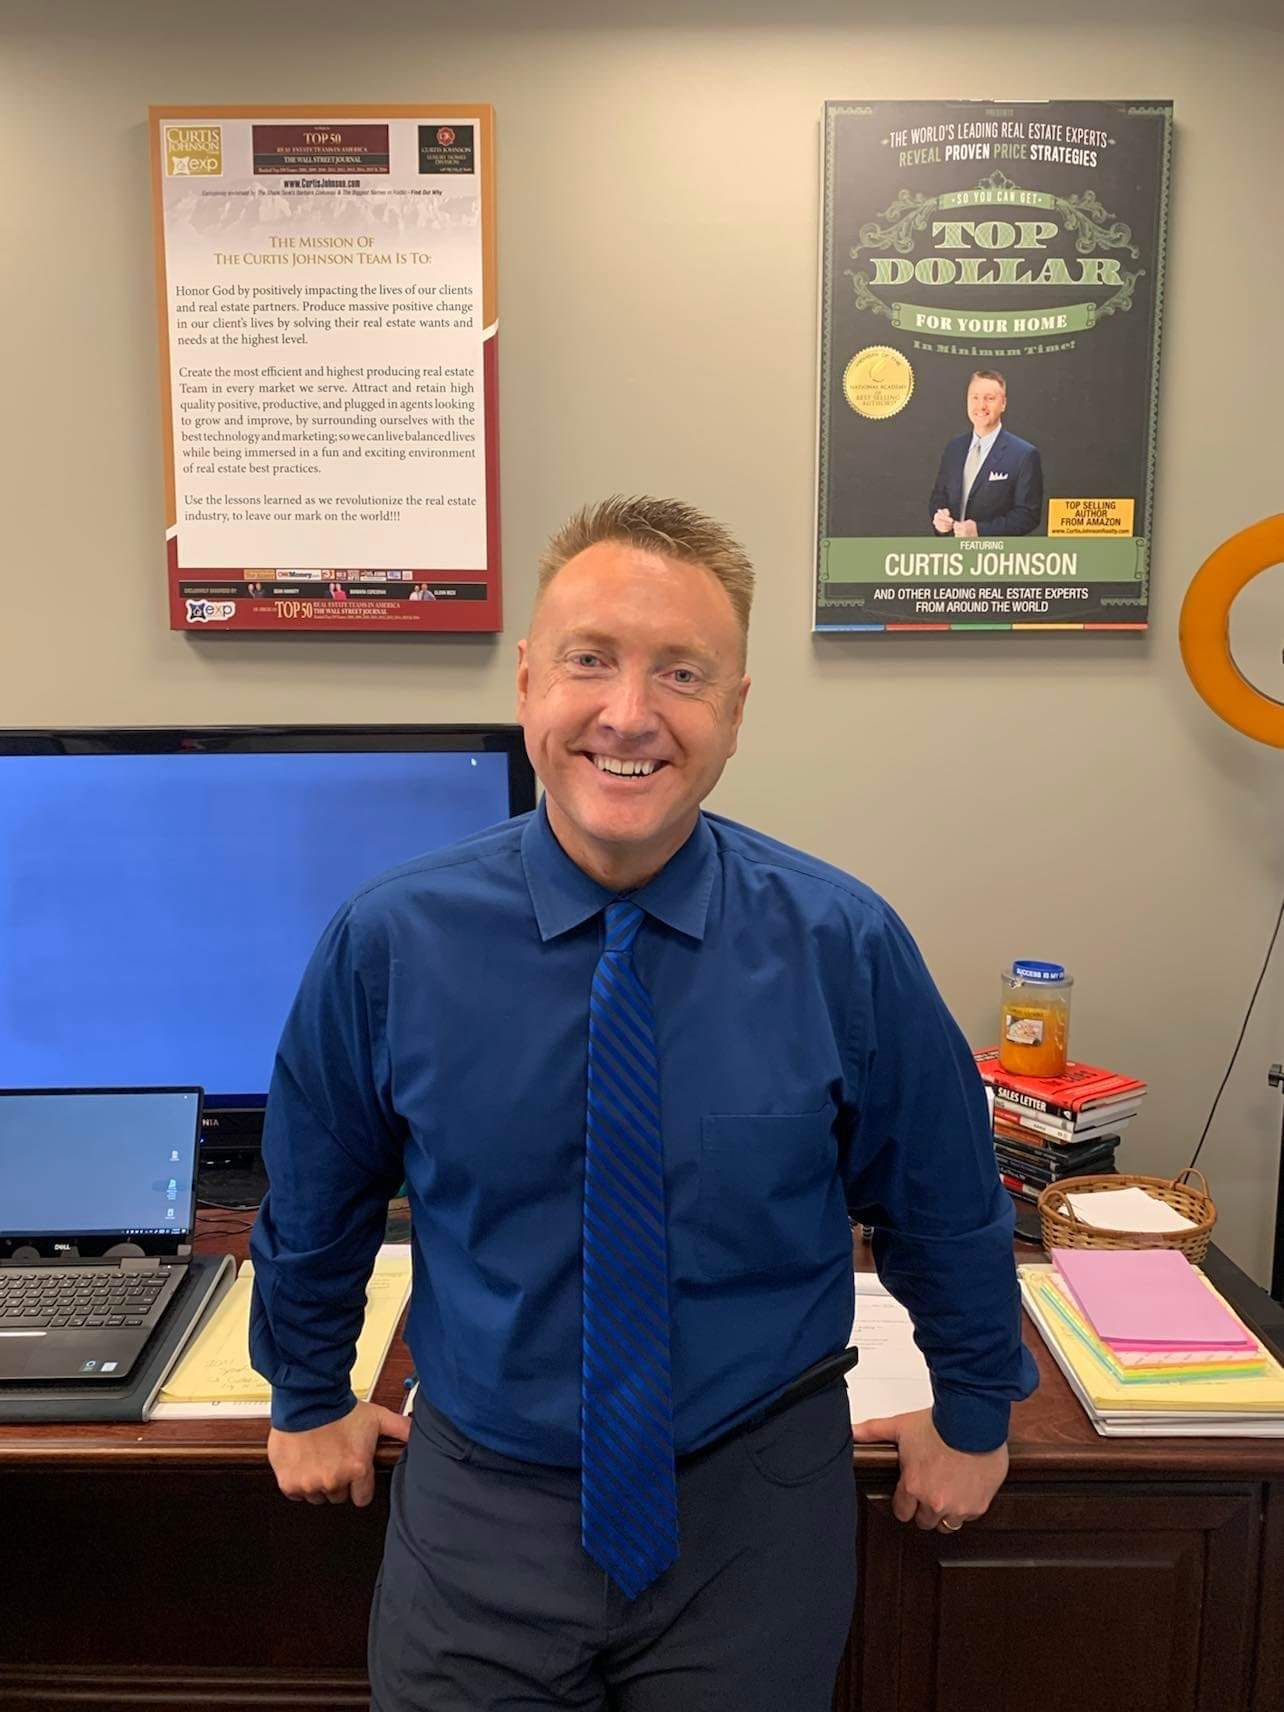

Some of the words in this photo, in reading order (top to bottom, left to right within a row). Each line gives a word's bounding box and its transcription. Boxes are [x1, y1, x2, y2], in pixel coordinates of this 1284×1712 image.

[168, 128, 220, 142] CURTIS
[304, 133, 328, 144] TOP
[330, 133, 341, 144] 50
[890, 131, 908, 148] THE
[911, 125, 955, 144] WORLD'S
[958, 122, 998, 140] LEADING
[1001, 122, 1024, 138] REAL
[1029, 124, 1062, 142] ESTATE
[1066, 127, 1108, 148] EXPERTS
[168, 142, 220, 153] JOHNSON
[899, 146, 941, 167] REVEAL
[945, 143, 990, 161] PROVEN
[993, 143, 1027, 160] PRICE
[1030, 146, 1097, 168] STRATEGIES
[284, 178, 360, 188] www.CurtisJohnson.com
[957, 192, 970, 204] SO
[974, 191, 992, 203] YOU
[996, 191, 1016, 204] CAN
[1019, 192, 1037, 205] GET
[270, 236, 296, 248] THE
[299, 236, 353, 248] MISSION
[357, 236, 375, 248] OF
[932, 221, 1059, 249] TOP
[215, 253, 240, 264] THE
[243, 253, 289, 264] CURTIS
[292, 253, 353, 266] JOHNSON
[356, 253, 392, 264] TEAM
[396, 253, 408, 264] IS
[410, 252, 432, 264] TO:
[869, 258, 1125, 286] DOLLAR
[176, 286, 210, 296] Honor
[212, 284, 235, 296] God
[238, 284, 250, 298] by
[252, 284, 302, 298] positively
[305, 285, 358, 298] impacting
[360, 284, 377, 295] the
[379, 284, 403, 296] lives
[405, 284, 416, 296] of
[439, 284, 472, 295] clients
[176, 301, 196, 312] and
[199, 301, 218, 312] real
[221, 304, 250, 312] estate
[253, 303, 299, 314] partners.
[302, 300, 346, 312] Produce
[348, 302, 389, 312] massive
[392, 301, 434, 314] positive
[436, 300, 473, 314] change
[178, 319, 188, 328] in
[191, 320, 209, 328] our
[213, 317, 248, 328] client's
[250, 317, 274, 328] lives
[277, 317, 290, 331] by
[293, 317, 331, 331] solving
[334, 317, 359, 328] their
[363, 316, 382, 328] real
[386, 318, 416, 328] estate
[420, 319, 450, 328] wants
[454, 317, 473, 328] and
[916, 314, 952, 330] FOR
[958, 317, 1008, 333] YOUR
[1015, 314, 1067, 332] HOME
[178, 334, 207, 345] needs
[210, 336, 219, 344] at
[222, 334, 238, 344] the
[241, 333, 279, 347] highest
[282, 333, 308, 344] level.
[913, 340, 932, 352] In
[936, 343, 1021, 357] Minimum
[1024, 340, 1075, 356] Time!
[183, 463, 194, 473] of
[196, 463, 214, 473] real
[218, 465, 246, 473] estate
[249, 463, 270, 473] best
[272, 464, 321, 476] practices.
[184, 495, 203, 505] Use
[206, 494, 222, 504] the
[225, 494, 261, 505] lessons
[264, 494, 302, 504] learned
[336, 494, 403, 505] revolutionize
[406, 495, 422, 505] the
[426, 495, 444, 505] real
[448, 498, 476, 506] estate
[1066, 501, 1081, 509] TOP
[1083, 501, 1116, 509] SELLING
[185, 510, 229, 523] industry,
[232, 512, 242, 520] to
[245, 510, 271, 520] leave
[273, 512, 292, 520] our
[294, 510, 322, 520] mark
[341, 510, 357, 520] the
[360, 510, 400, 521] world!!!
[1060, 518, 1084, 526] FROM
[1086, 518, 1121, 526] AMAZON
[960, 541, 1004, 550] FEATURING
[885, 553, 963, 576] CURTIS
[970, 553, 1077, 575] JOHNSON
[874, 588, 895, 599] AND
[897, 588, 930, 599] OTHER
[933, 588, 976, 599] LEADING
[978, 588, 1004, 599] REAL
[1006, 588, 1042, 599] ESTATE
[1044, 588, 1088, 599] EXPERTS
[206, 604, 233, 616] exp
[275, 601, 298, 618] TOP
[298, 603, 312, 618] 50
[916, 601, 945, 612] FROM
[946, 601, 989, 612] AROUND
[990, 601, 1009, 612] THE
[1011, 601, 1048, 612] WORLD
[998, 1087, 1020, 1102] SALES
[1020, 1093, 1046, 1112] LETTER
